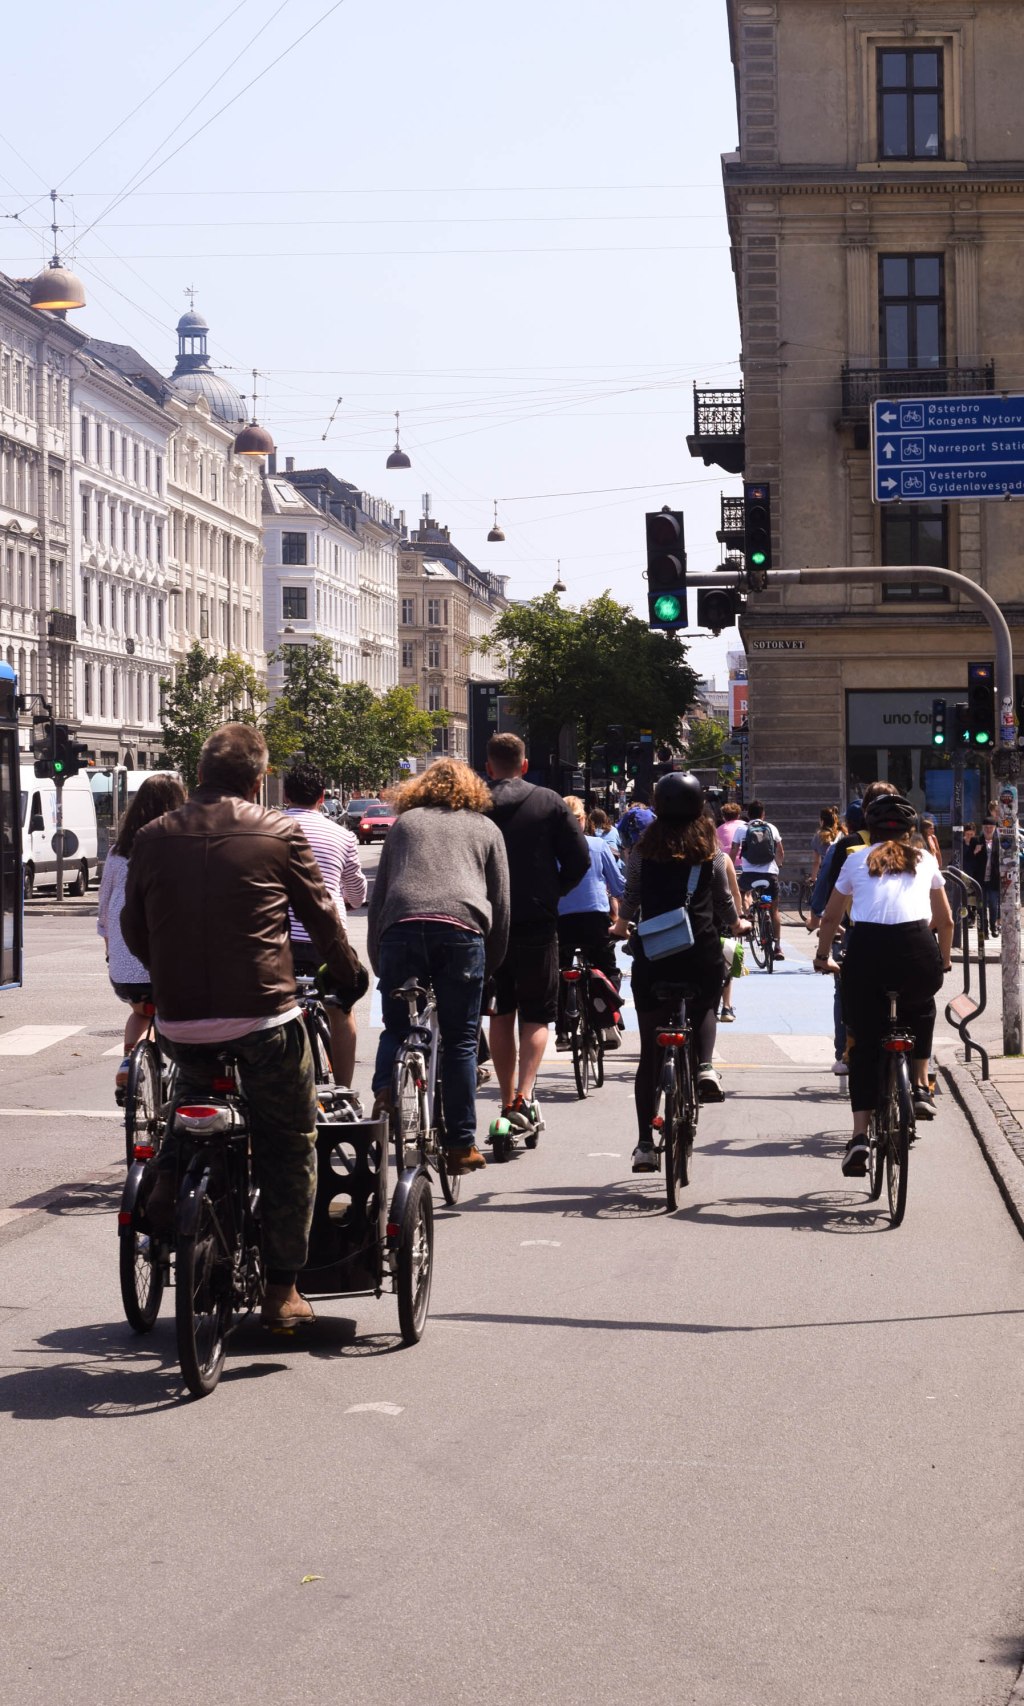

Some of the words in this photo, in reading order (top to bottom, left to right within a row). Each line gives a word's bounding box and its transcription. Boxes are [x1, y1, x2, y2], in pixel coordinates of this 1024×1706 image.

[928, 404, 980, 414] Østerbro
[928, 416, 977, 427] Kongens
[982, 414, 1022, 425] Nytorv
[928, 443, 986, 454] Nørreport
[929, 470, 987, 480] Vesterbro
[929, 480, 1024, 493] Gyldenløvesgad
[883, 713, 912, 725] uno
[913, 710, 933, 724] for
